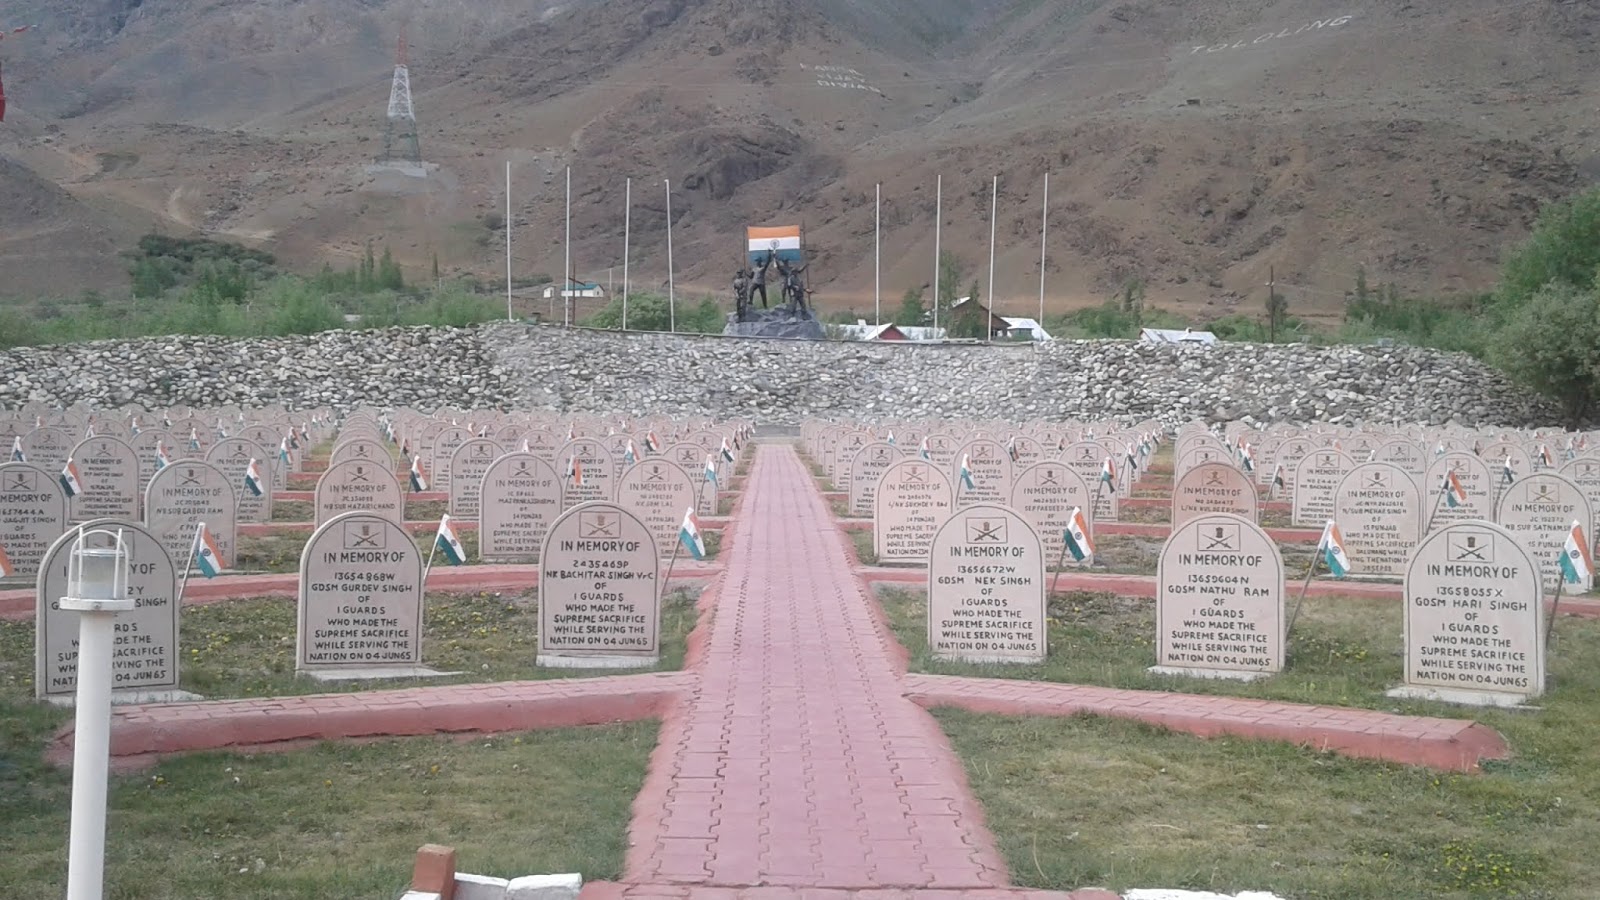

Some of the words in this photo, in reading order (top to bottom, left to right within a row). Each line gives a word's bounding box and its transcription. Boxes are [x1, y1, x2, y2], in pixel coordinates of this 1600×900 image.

[1190, 15, 1352, 54] TOLOLING
[330, 485, 339, 493] IN
[376, 484, 386, 492] OF
[899, 482, 930, 491] MEMORY
[1195, 486, 1232, 496] MEMORY
[163, 488, 173, 496] IN
[174, 488, 210, 496] MEMORY
[212, 488, 221, 496] OF
[40, 494, 52, 502] OF
[1525, 504, 1561, 513] MEMORY
[1563, 505, 1574, 513] OF
[561, 541, 573, 551] IN
[577, 541, 624, 551] MEMORY
[626, 542, 640, 551] OF
[951, 547, 961, 556] IN
[965, 547, 1009, 557] MEMORY
[1012, 547, 1024, 557] OF
[324, 553, 336, 564] IN
[341, 552, 389, 562] MEMORY
[391, 552, 405, 562] OF
[1179, 554, 1191, 565] IN
[1195, 554, 1244, 566] MEMORY
[1247, 556, 1262, 567] OF
[140, 563, 155, 574] OF
[573, 560, 628, 568] 2435469P
[545, 570, 558, 578] NK
[560, 570, 605, 579] BACHITAR
[1428, 565, 1440, 575] IN
[1445, 565, 1499, 578] MEMORY
[1502, 567, 1517, 578] OF
[335, 572, 395, 581] 13654868W
[938, 576, 964, 584] GDSM
[975, 577, 995, 585] NEK
[1001, 577, 1030, 585] SINGH
[341, 584, 379, 592] GURDEV
[594, 582, 606, 590] OF
[1168, 585, 1195, 593] GDSM
[1200, 586, 1235, 594] NATHU
[1244, 587, 1269, 596] RAM
[580, 592, 623, 602] GUARDS
[1435, 587, 1502, 598] 13658055X
[135, 598, 167, 607] SINGH
[966, 599, 1007, 607] GUARDS
[1213, 598, 1225, 606] OF
[1415, 597, 1446, 606] GDSM
[1453, 599, 1481, 608] HARI
[1490, 600, 1527, 611] SINGH
[343, 606, 385, 614] GUARDS
[566, 604, 587, 612] WHO
[590, 604, 614, 612] MADE
[618, 604, 634, 613] THE
[1200, 608, 1244, 618] GUARDS
[1004, 610, 1021, 618] THE
[1465, 613, 1478, 621] OF
[353, 619, 379, 627] MADE
[554, 614, 596, 623] SUPREME
[599, 615, 645, 624] SACRIFICE
[942, 620, 982, 628] SUPREME
[985, 621, 1032, 629] SACRIFICE
[1209, 621, 1234, 629] MADE
[1237, 622, 1255, 630] THE
[1449, 623, 1498, 634] GUARDS
[315, 630, 358, 638] SUPREME
[361, 629, 408, 638] SACRIFICE
[554, 626, 583, 634] WHILE
[586, 625, 625, 634] SERVING
[132, 635, 151, 643] THE
[942, 631, 971, 639] WHILE
[974, 632, 1013, 640] SERVING
[1016, 632, 1033, 640] THE
[1172, 630, 1214, 640] SUPREME
[1218, 632, 1267, 643] SACRIFICE
[315, 641, 345, 650] WHILE
[348, 641, 388, 649] SERVING
[938, 642, 972, 650] NATION
[975, 642, 988, 650] ON
[1433, 636, 1457, 644] WHO
[1461, 637, 1488, 646] MADE
[1492, 638, 1511, 647] THE
[1172, 643, 1202, 651] WHILE
[1205, 644, 1247, 653] SERVING
[1249, 645, 1267, 654] THE
[1168, 653, 1203, 662] NATION
[1207, 655, 1220, 663] ON
[1223, 656, 1237, 664] 04
[1421, 646, 1466, 657] SUPREME
[1470, 649, 1525, 662] SACRIFICE
[145, 658, 164, 667] THE
[1421, 659, 1454, 668] WHILE
[1457, 661, 1502, 672] SERVING
[1506, 664, 1525, 673] THE
[115, 673, 130, 681] 04
[1417, 671, 1455, 680] NATION
[1459, 673, 1473, 681] ON
[1476, 675, 1491, 683] 04
